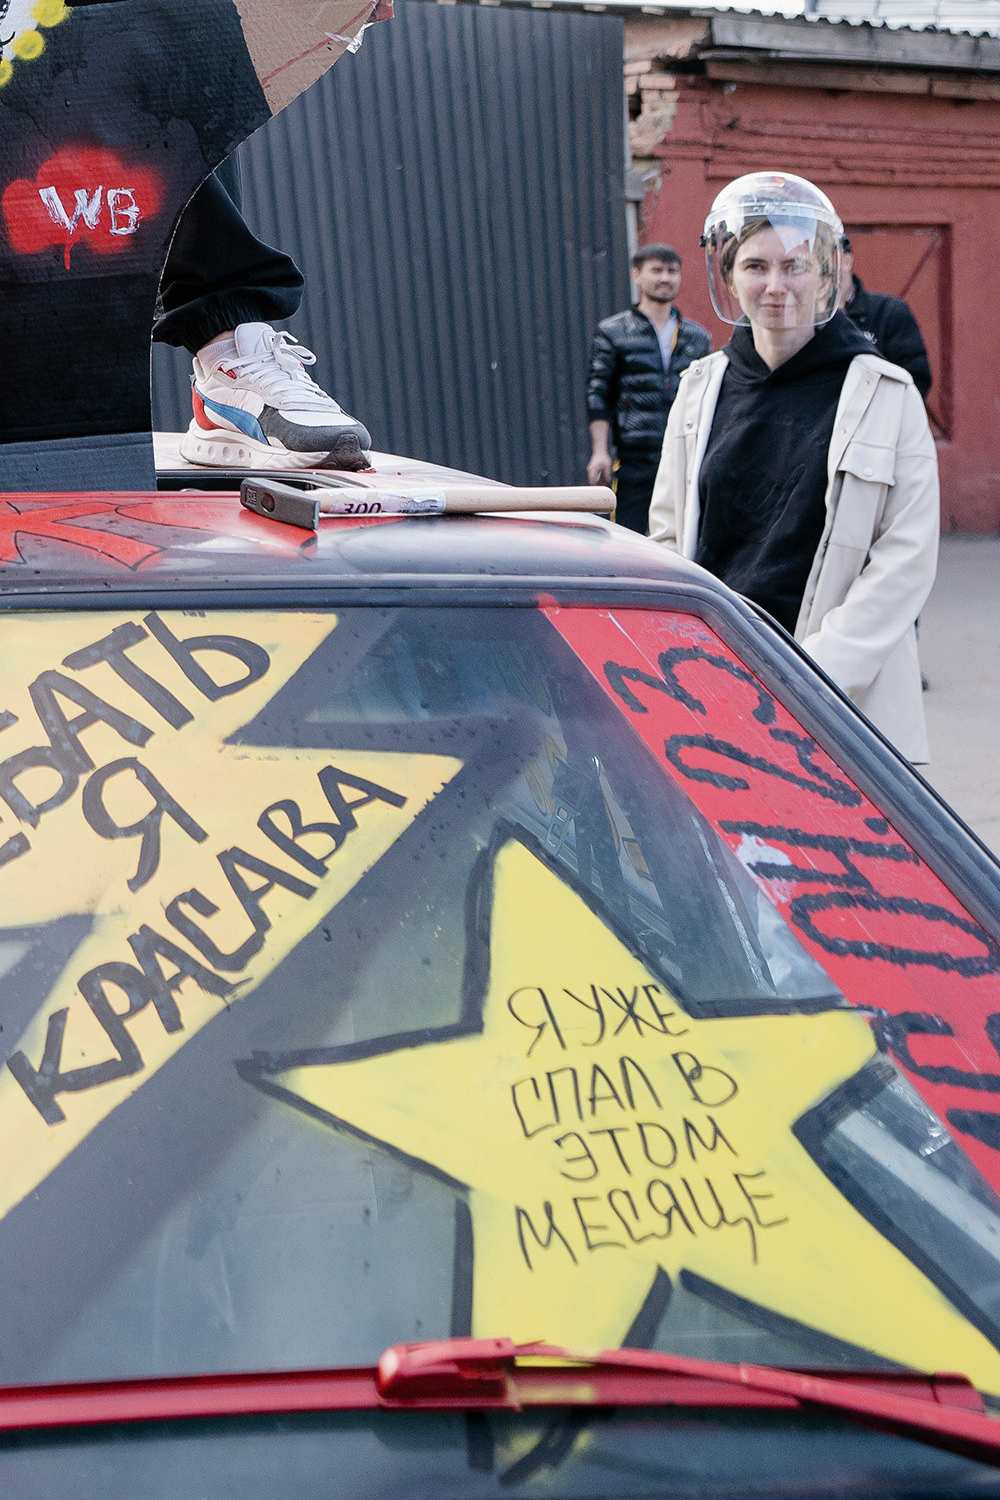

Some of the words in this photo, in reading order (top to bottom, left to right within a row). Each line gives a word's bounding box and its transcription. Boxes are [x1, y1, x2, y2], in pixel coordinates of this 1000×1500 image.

[38, 185, 141, 236] WB
[81, 756, 208, 892] Я
[7, 765, 408, 1127] КРАСАВА
[507, 986, 567, 1058] Я
[562, 984, 690, 1047] УЖЕ
[511, 1056, 663, 1138] СПАЛ
[671, 1051, 738, 1108] В
[554, 1115, 739, 1181] ЭТОМ
[514, 1171, 789, 1273] МЕСЯЦЕ
